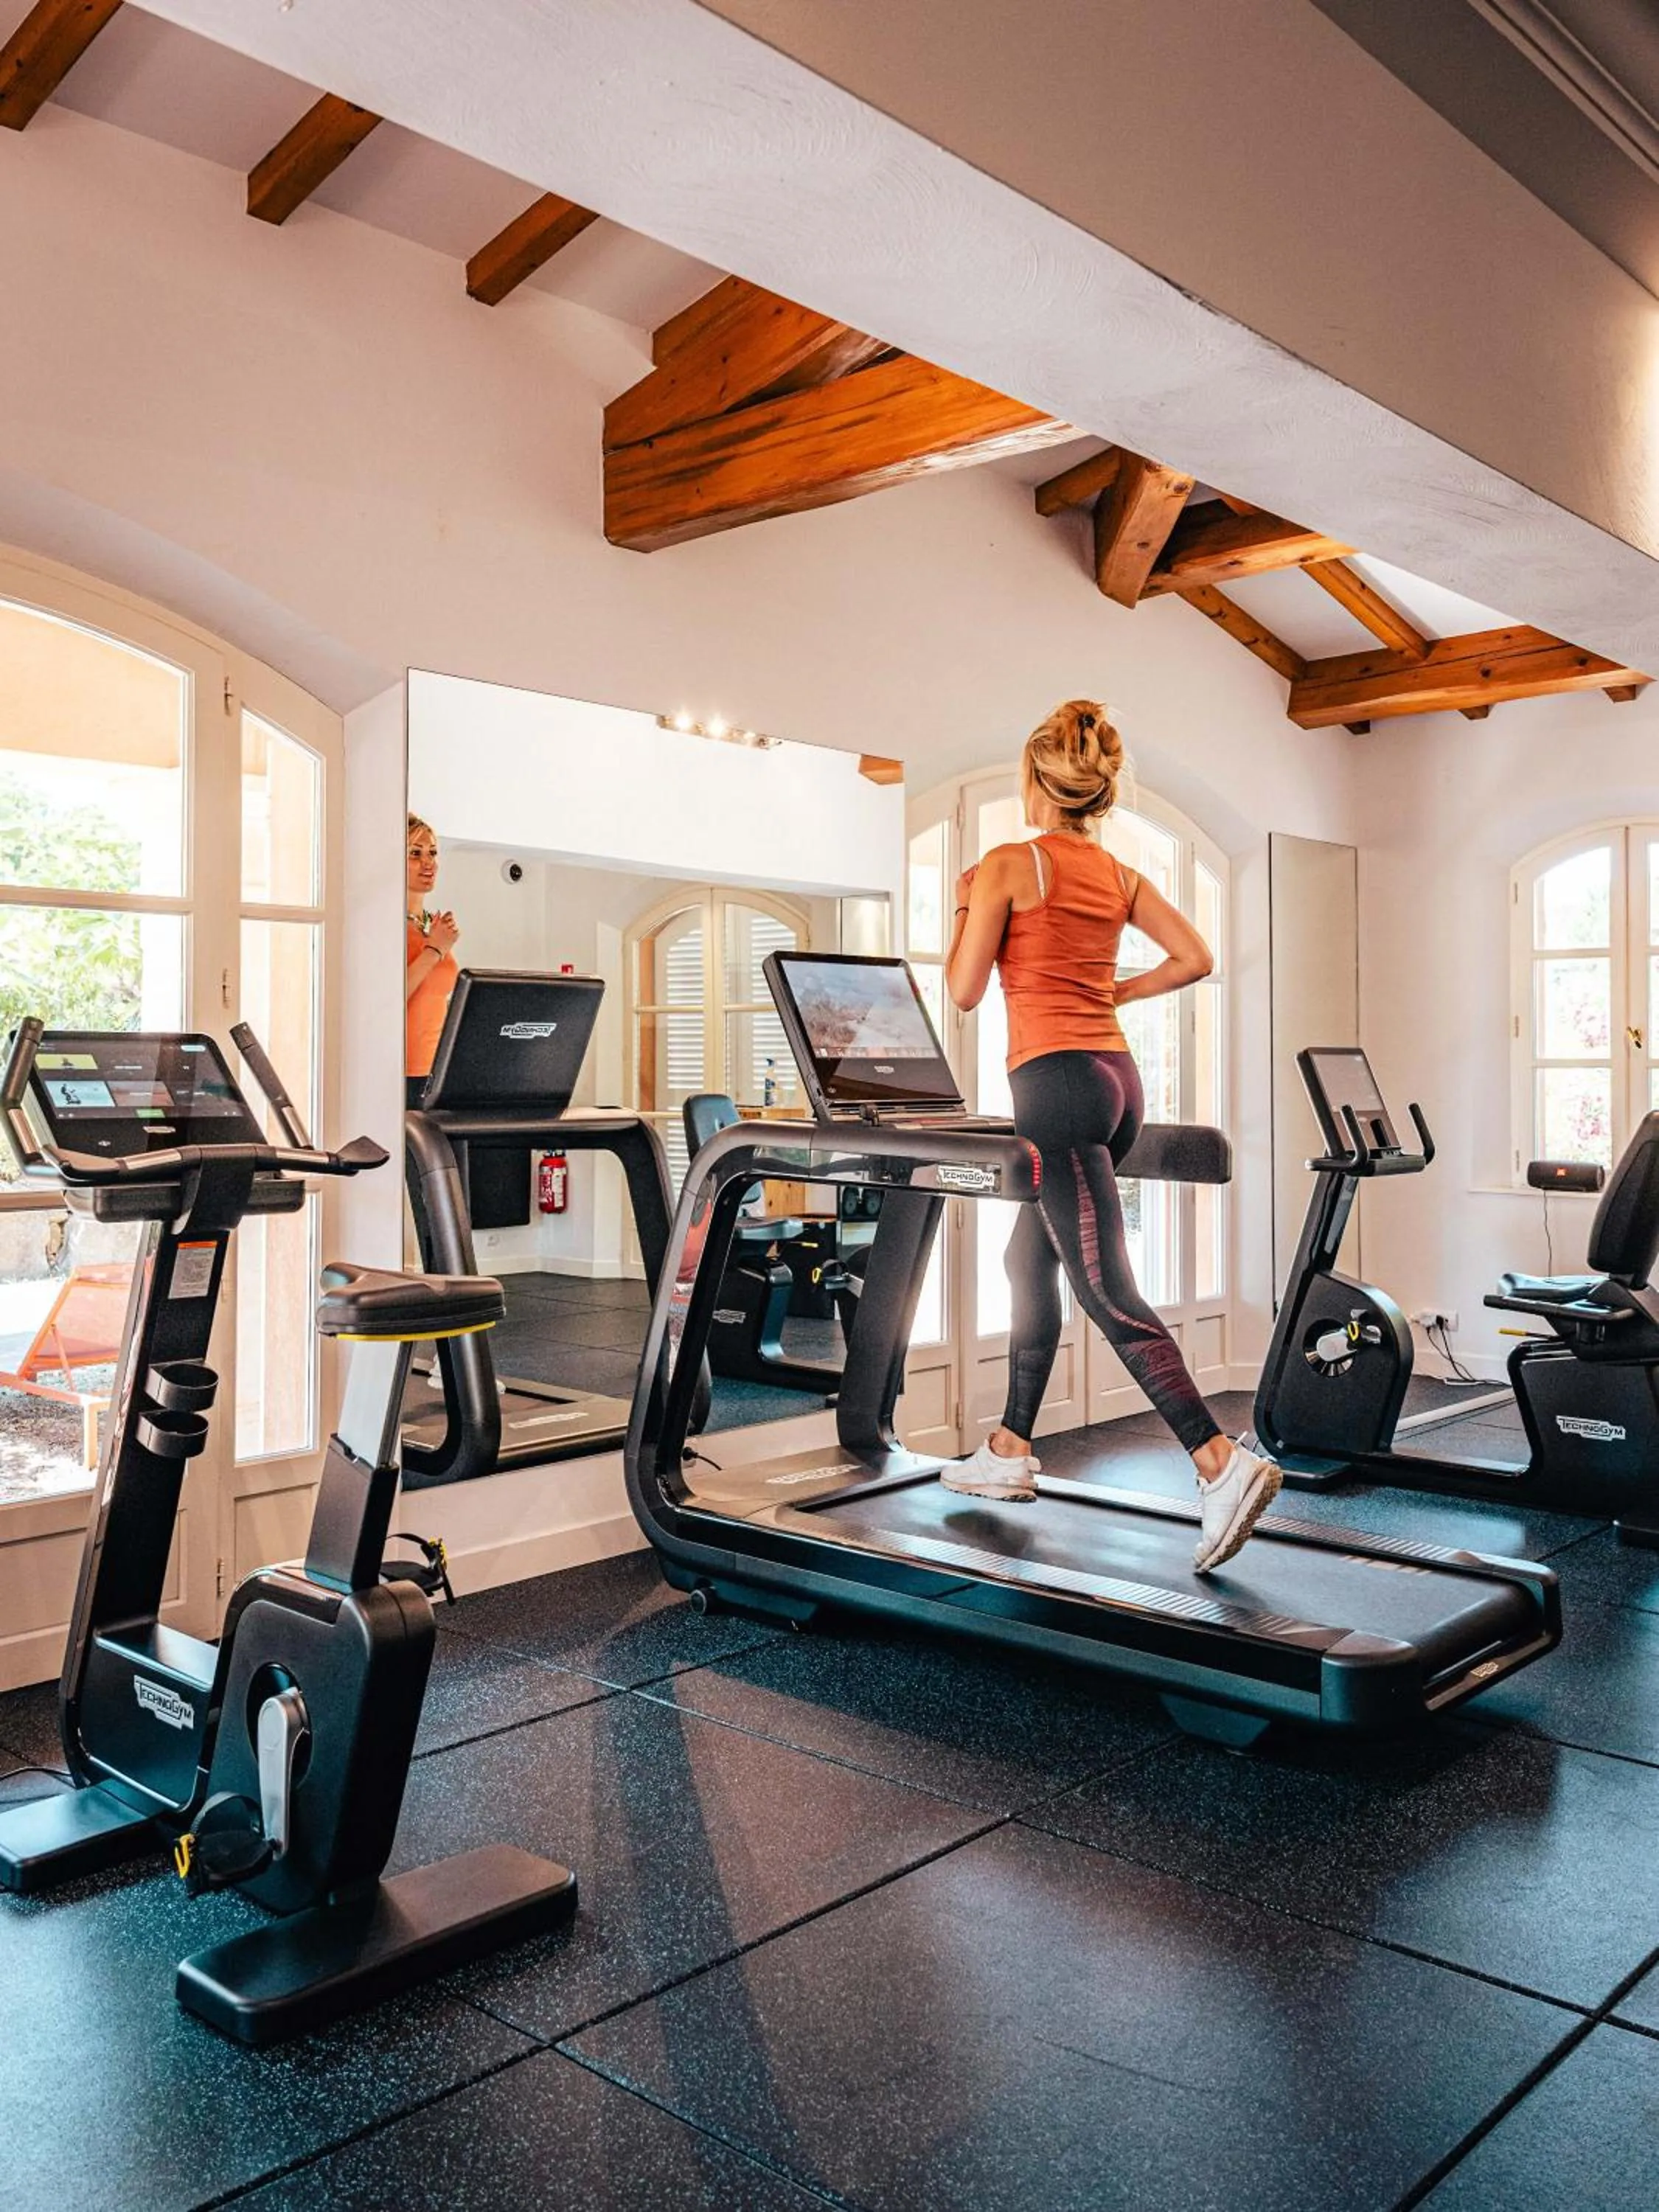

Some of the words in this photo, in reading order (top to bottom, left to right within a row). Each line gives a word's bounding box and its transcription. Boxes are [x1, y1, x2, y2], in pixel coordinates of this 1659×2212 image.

[940, 1166, 993, 1185] TECHNOGYM
[1558, 1418, 1624, 1438] TECHNOGYM
[135, 1679, 192, 1722] TECHNOGYM
